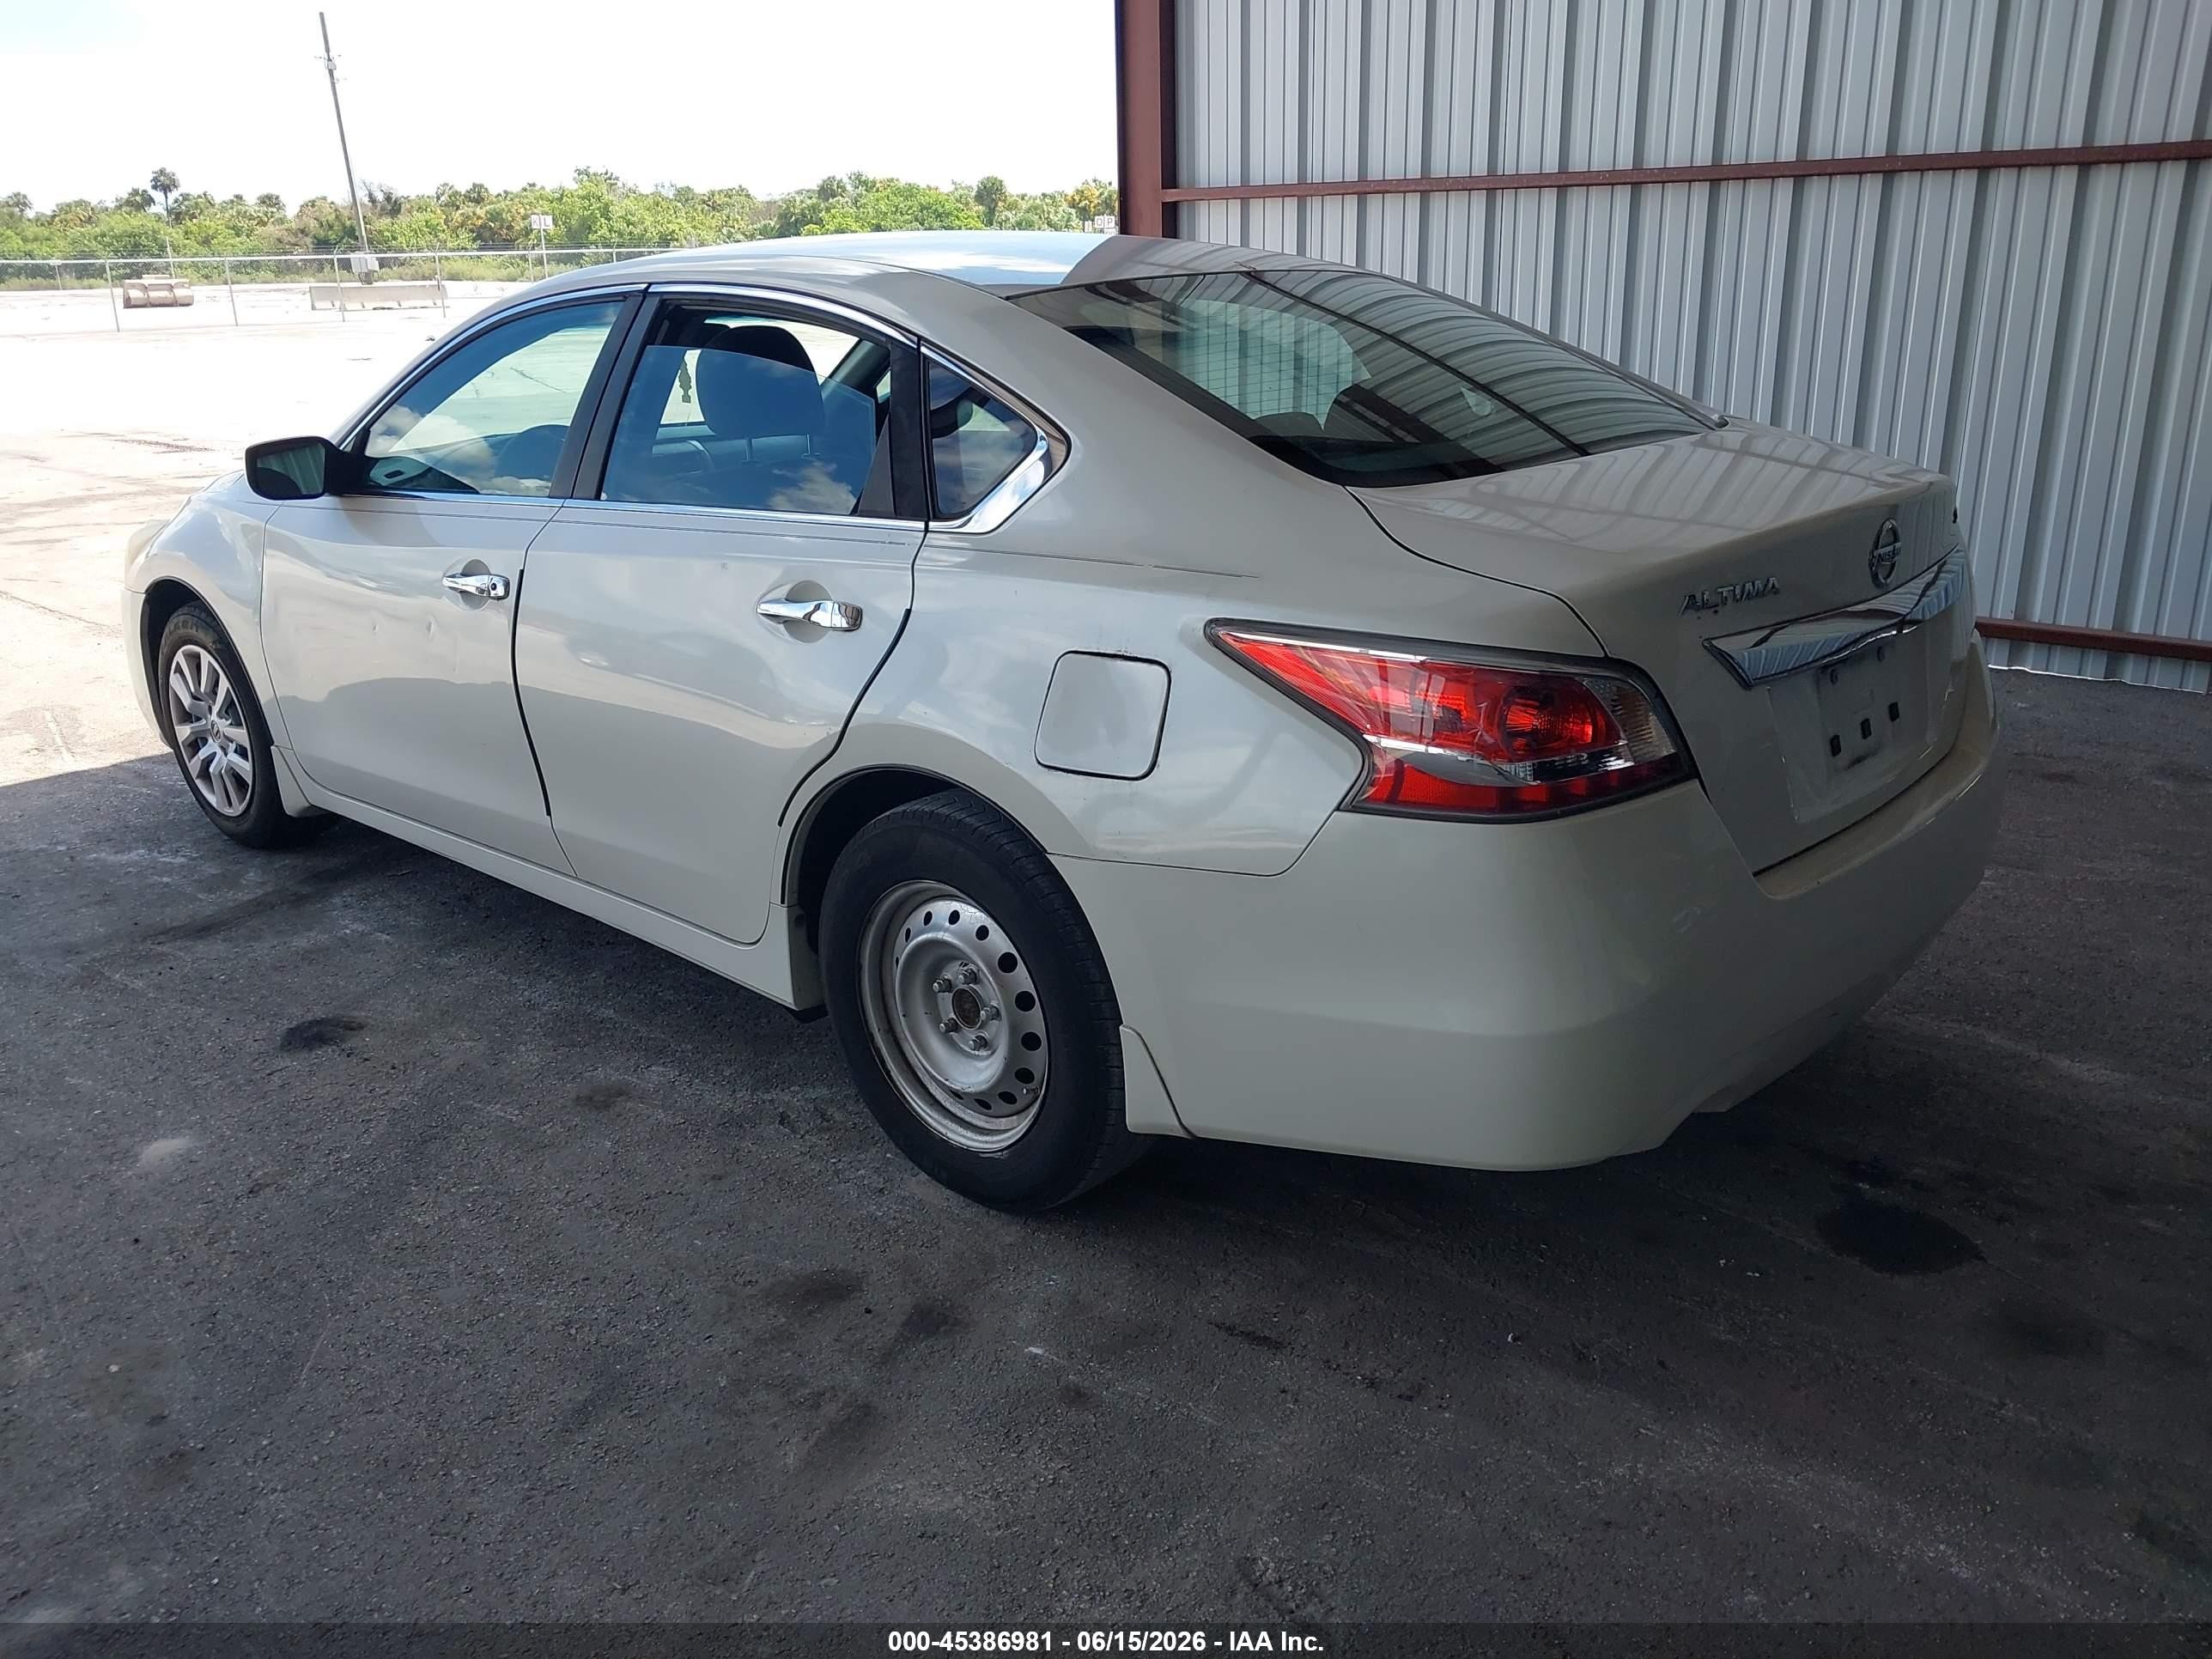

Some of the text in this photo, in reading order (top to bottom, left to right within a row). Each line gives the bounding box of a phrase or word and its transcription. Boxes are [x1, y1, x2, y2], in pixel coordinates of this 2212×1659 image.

[533, 216, 550, 227] K L
[1108, 217, 1113, 227] P
[1678, 576, 1779, 616] ALTIMA
